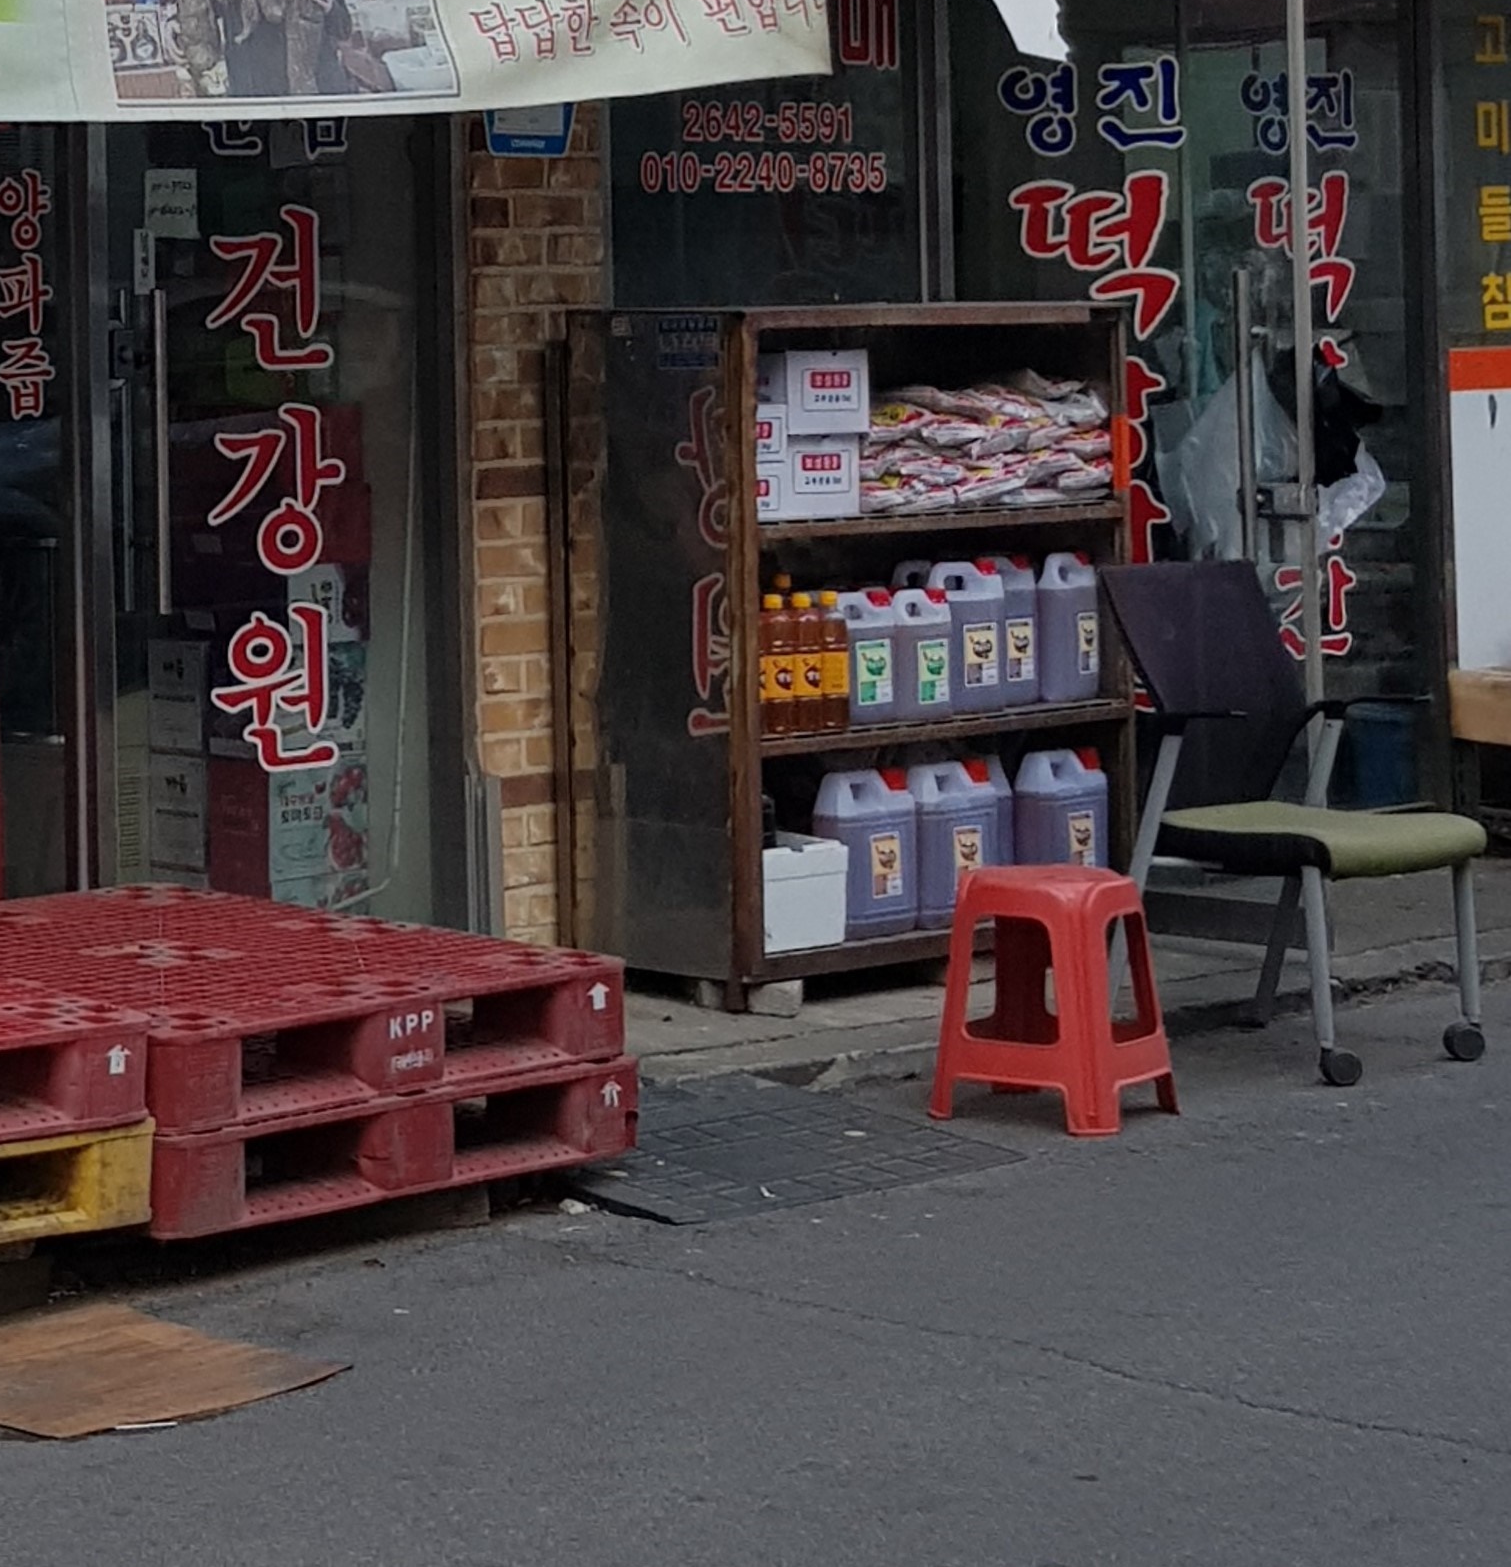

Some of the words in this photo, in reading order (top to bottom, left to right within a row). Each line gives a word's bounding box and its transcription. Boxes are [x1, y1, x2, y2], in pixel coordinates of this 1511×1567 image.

[682, 100, 853, 143] 2642-5591
[997, 55, 1187, 157] 영진
[640, 151, 887, 193] 010-2240-8735
[205, 204, 346, 772] 건강원
[389, 1009, 435, 1041] KPP
